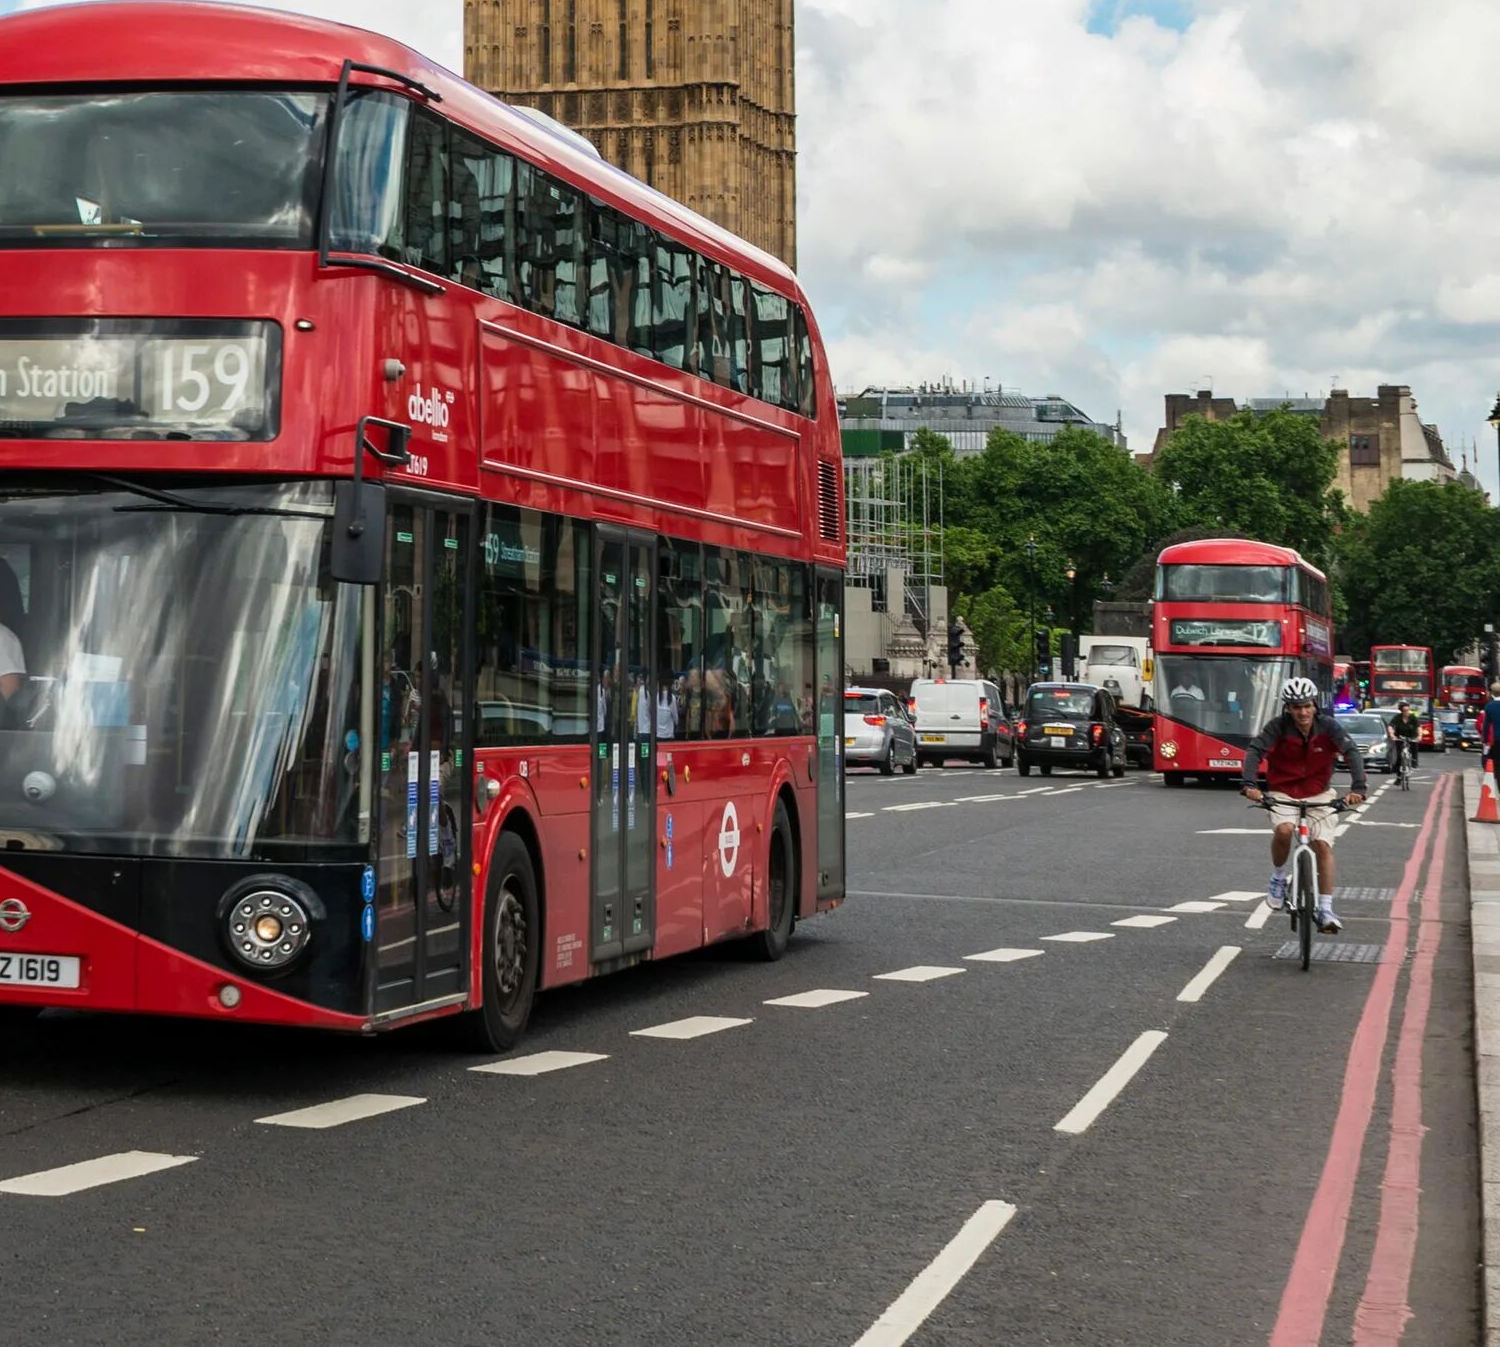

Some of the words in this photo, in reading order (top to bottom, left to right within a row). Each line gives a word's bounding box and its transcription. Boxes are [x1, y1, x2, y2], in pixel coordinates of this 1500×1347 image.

[16, 356, 109, 398] Station
[162, 344, 250, 412] 159
[408, 382, 449, 428] abellio
[1252, 623, 1269, 642] 12
[19, 957, 60, 982] 1619
